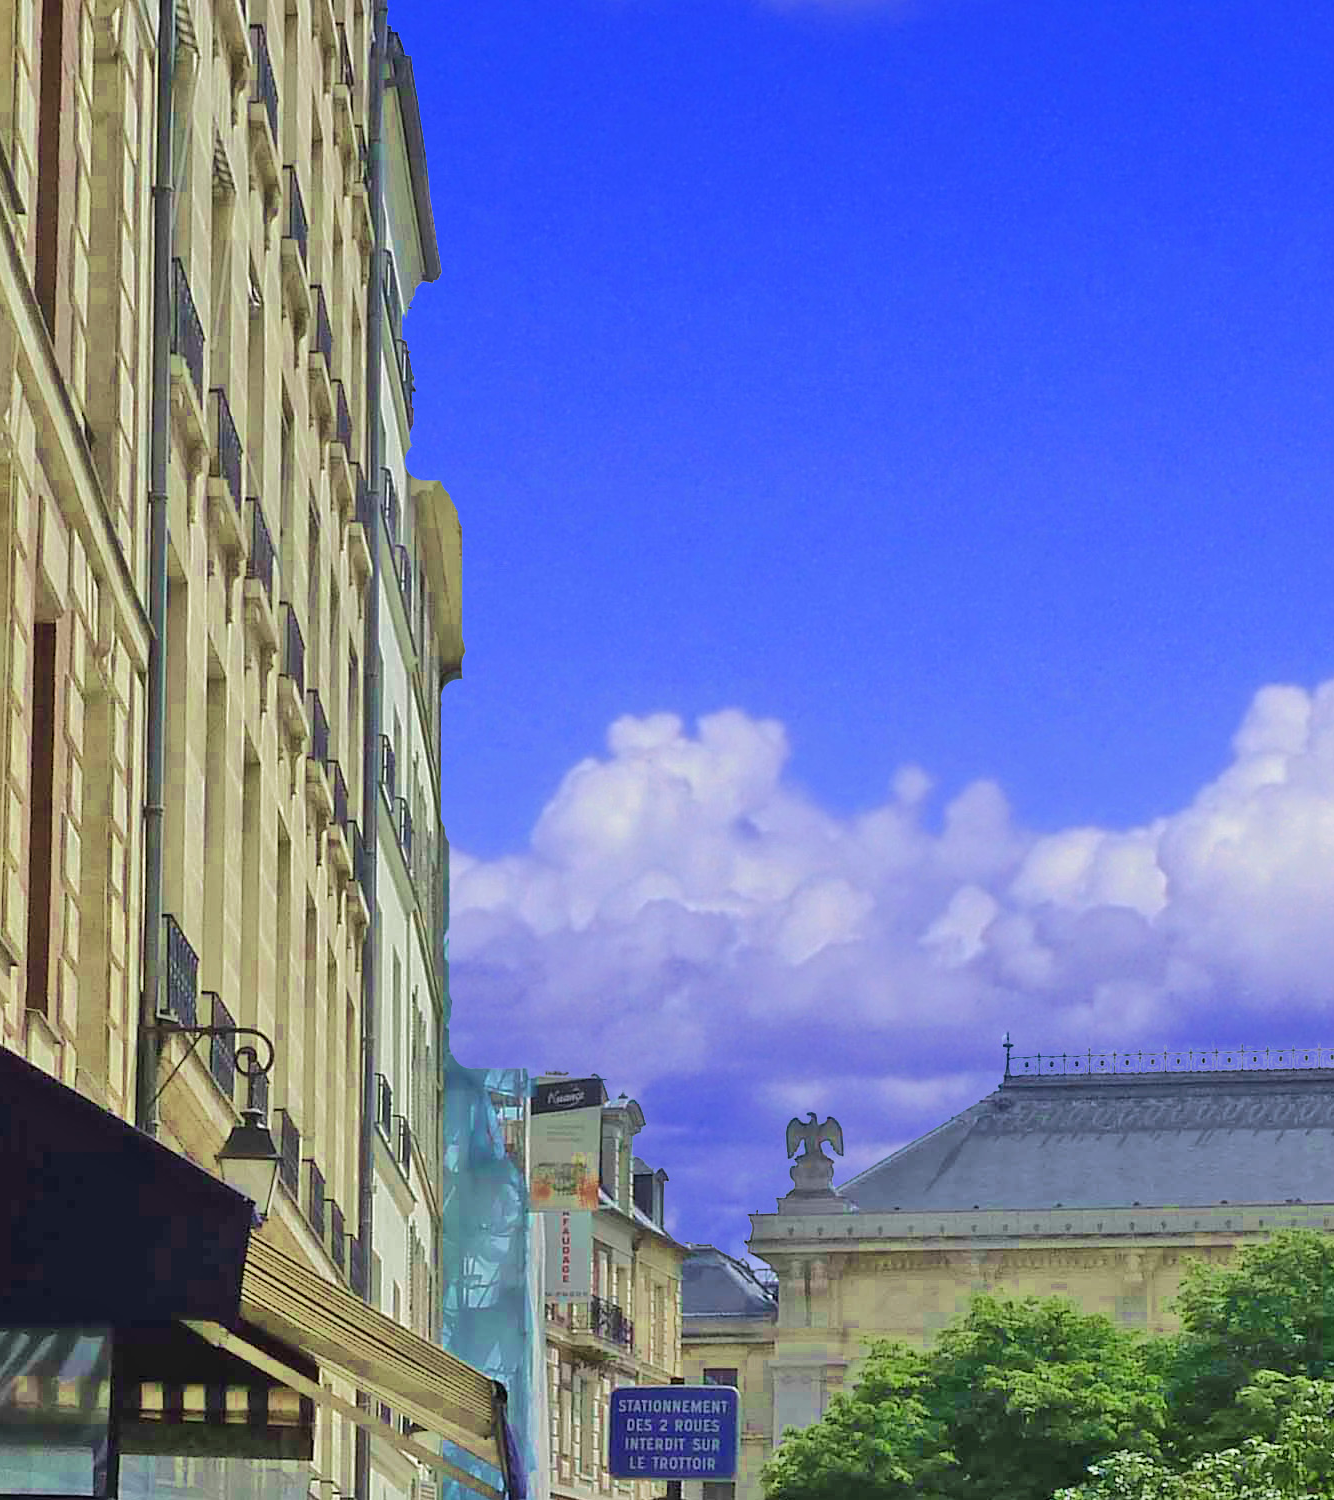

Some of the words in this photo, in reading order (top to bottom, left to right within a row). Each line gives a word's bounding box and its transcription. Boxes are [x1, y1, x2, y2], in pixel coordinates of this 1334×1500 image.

[618, 1400, 727, 1413] STATIONNEMENT
[627, 1419, 652, 1432] DES
[659, 1420, 668, 1432] 2
[675, 1419, 720, 1432] ROUES
[625, 1438, 684, 1451] INTERDIT
[692, 1439, 720, 1451] SUR
[629, 1456, 645, 1469] LE
[652, 1457, 715, 1470] TROTTOIR
